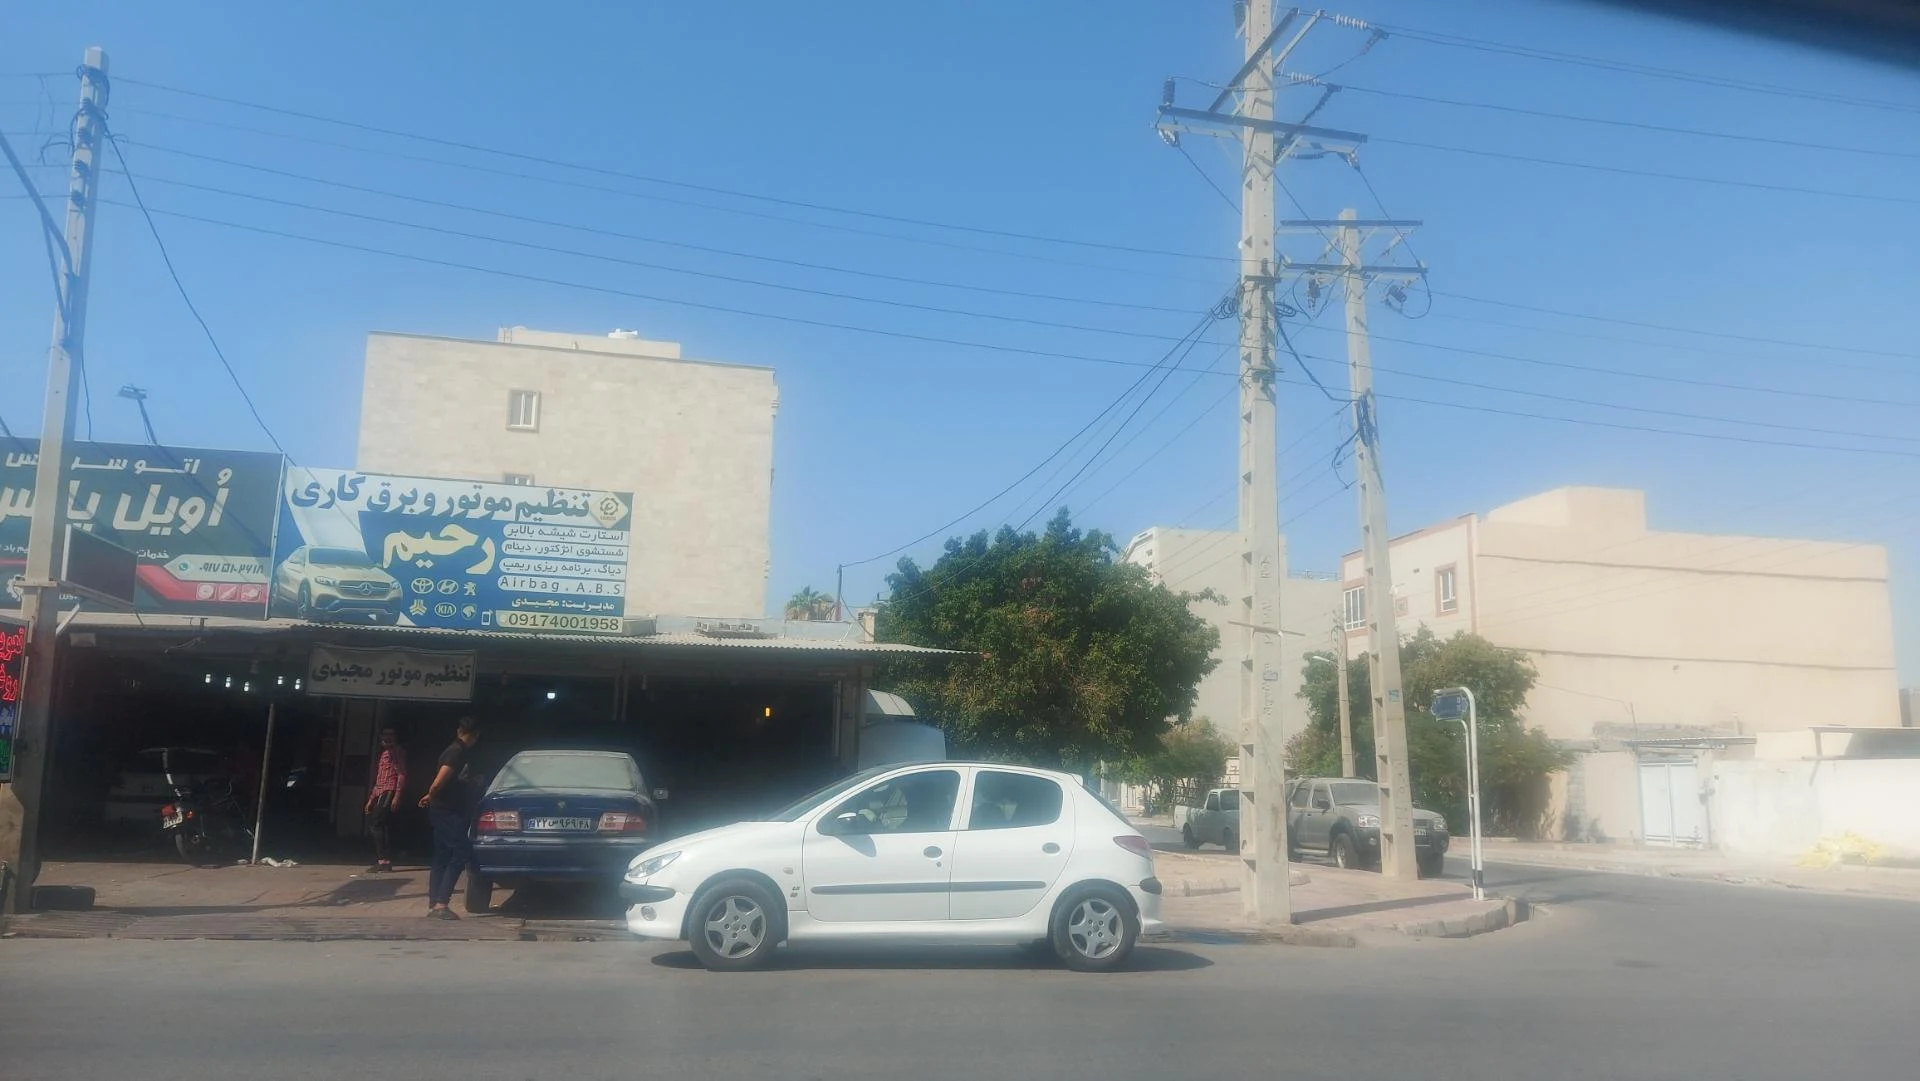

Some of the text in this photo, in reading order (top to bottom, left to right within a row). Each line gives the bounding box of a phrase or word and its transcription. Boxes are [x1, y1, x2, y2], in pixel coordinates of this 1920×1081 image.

[291, 474, 366, 510] کاری
[367, 481, 418, 516] برق
[437, 484, 512, 519] موتور
[515, 488, 592, 522] تنظیم
[507, 524, 624, 542] استارت شیشه بالابر
[383, 523, 496, 576] رحیم
[504, 540, 532, 552] دینام
[576, 546, 624, 557] شستشوی
[503, 562, 530, 571] ریمپ
[533, 561, 558, 573] ریزی
[561, 563, 591, 575] برنامه
[438, 604, 454, 615] KIA
[511, 597, 560, 609] مجیدی
[508, 613, 619, 631] 09174001958
[312, 662, 471, 687] تنظیم موتور مجیدی
